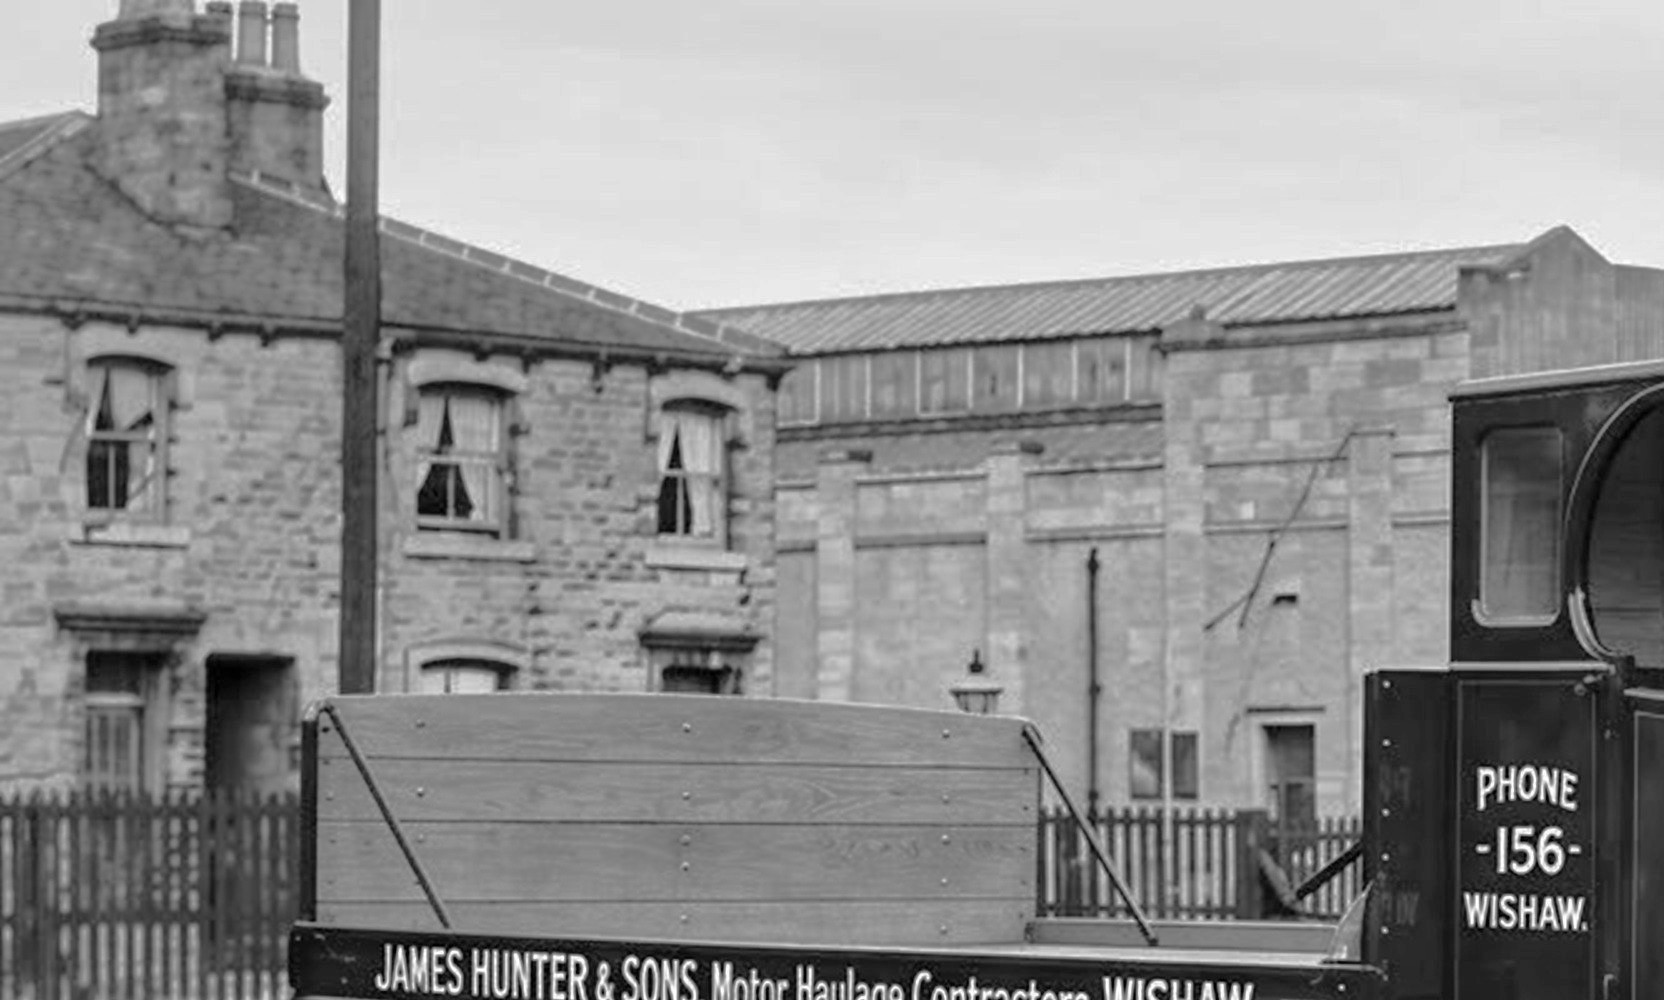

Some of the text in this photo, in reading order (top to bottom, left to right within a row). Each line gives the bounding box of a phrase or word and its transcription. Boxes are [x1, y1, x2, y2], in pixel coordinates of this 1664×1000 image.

[1477, 766, 1578, 811] PHONE
[1463, 892, 1588, 932] WISHAW.
[374, 943, 463, 995] JAMES
